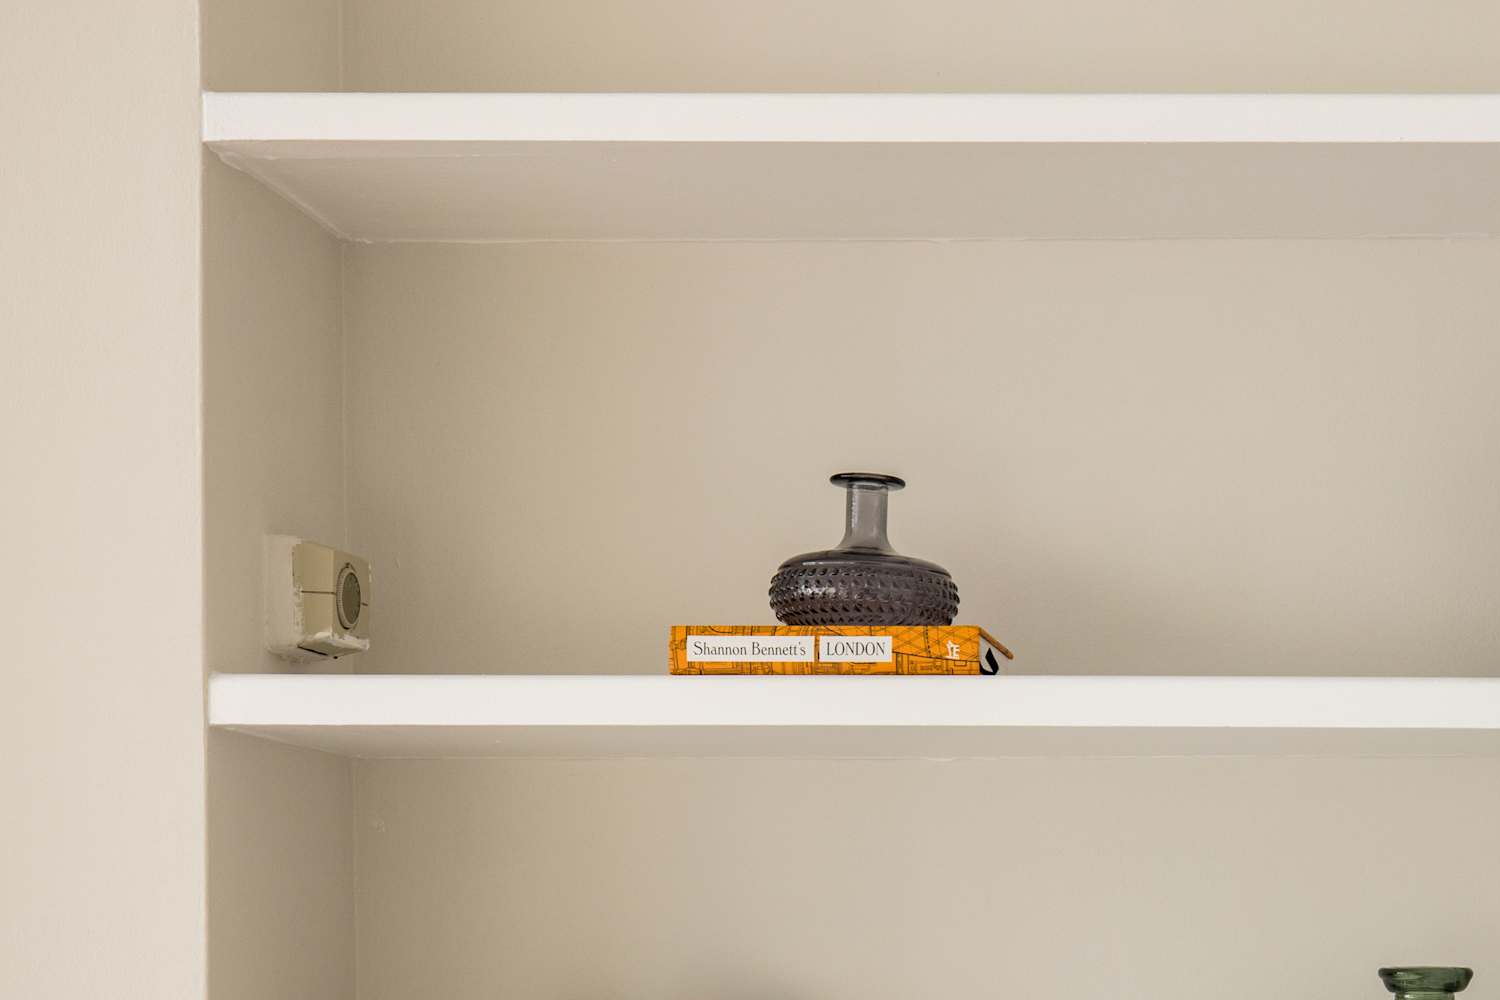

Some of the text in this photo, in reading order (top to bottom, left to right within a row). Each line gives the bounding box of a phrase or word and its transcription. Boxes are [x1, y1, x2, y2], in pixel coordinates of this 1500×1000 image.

[692, 640, 807, 657] Shannon Bennett's
[825, 641, 886, 657] LONDON
